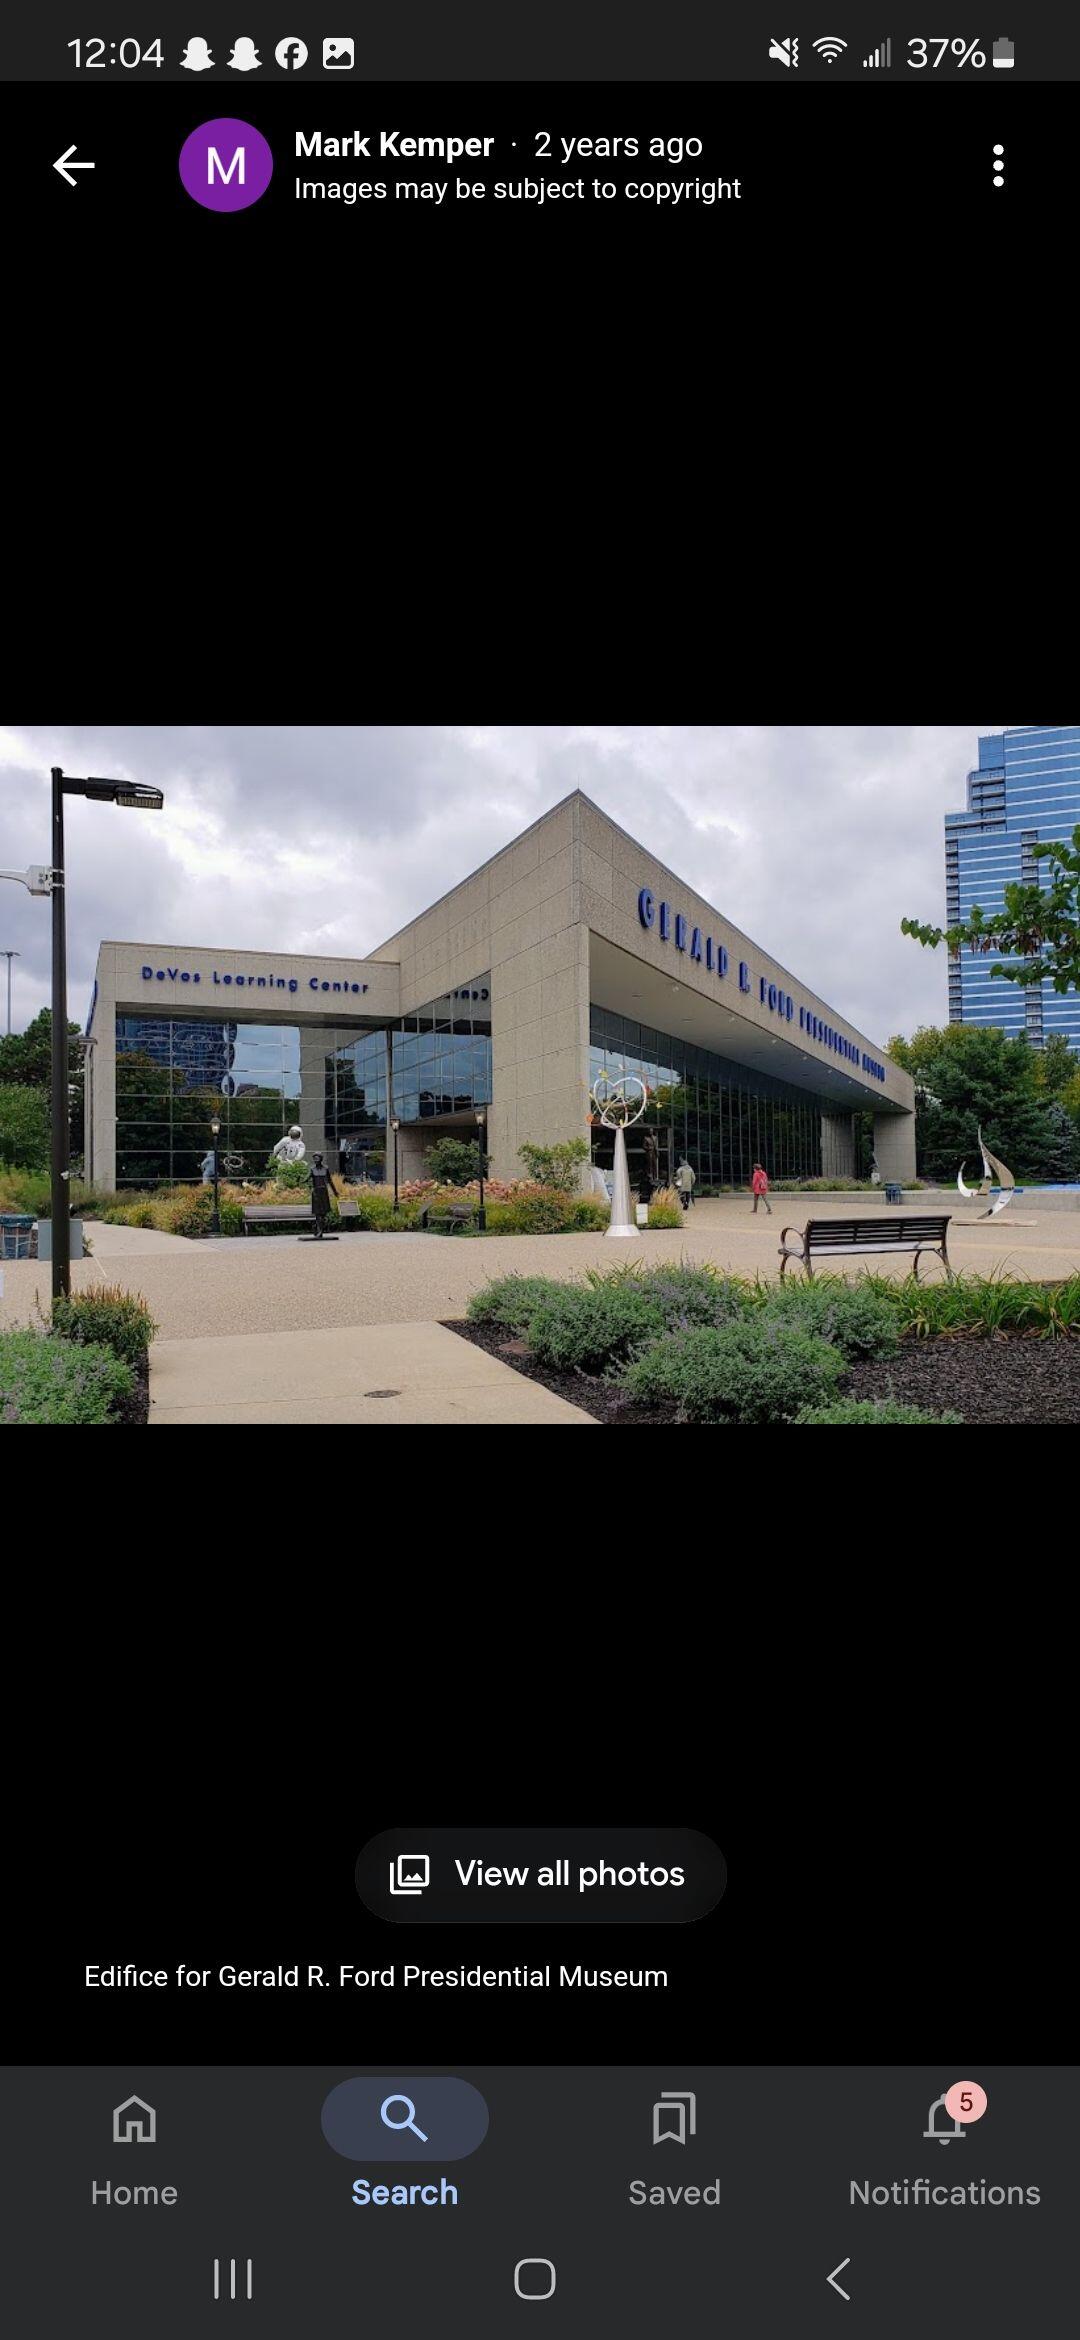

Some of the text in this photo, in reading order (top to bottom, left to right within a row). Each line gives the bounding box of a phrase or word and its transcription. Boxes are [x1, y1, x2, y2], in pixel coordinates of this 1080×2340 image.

[141, 965, 370, 995] DeVos Learning Center
[638, 887, 730, 978] GERALD
[760, 976, 795, 1022] FORD
